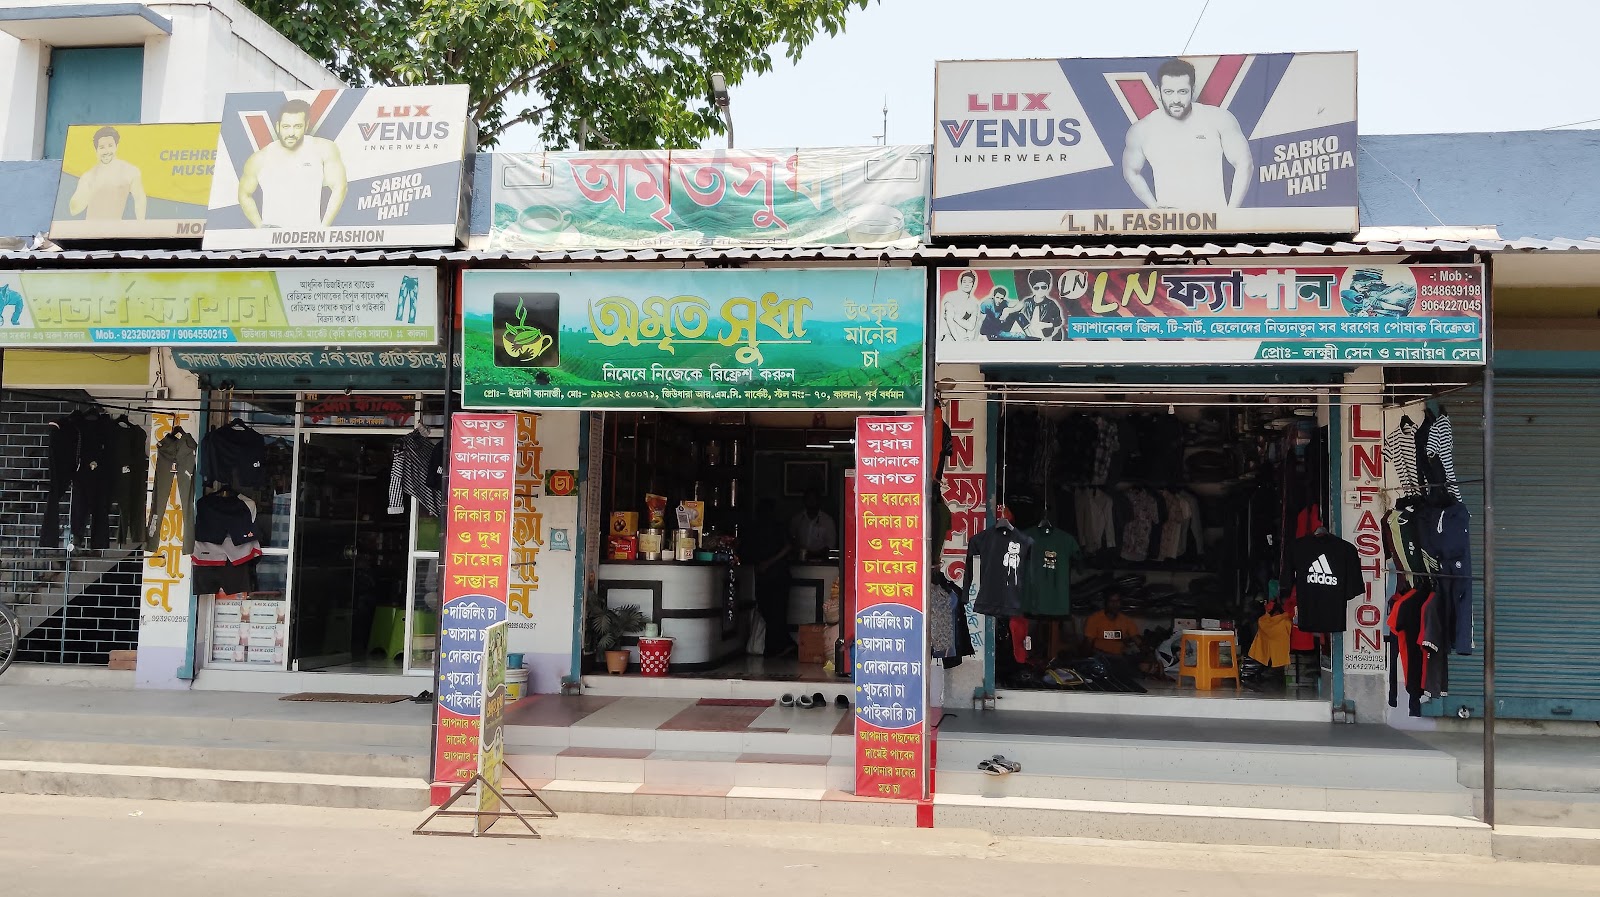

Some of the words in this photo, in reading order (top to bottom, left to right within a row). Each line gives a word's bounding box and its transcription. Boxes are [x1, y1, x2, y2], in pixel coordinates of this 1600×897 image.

[968, 92, 1051, 112] LUX
[377, 105, 432, 118] LUX
[358, 121, 449, 141] VENUS
[940, 118, 1081, 148] VENUS
[1274, 136, 1339, 162] SABKO
[955, 154, 1067, 162] INNERWEAR
[1260, 151, 1355, 183] MAANGTA
[371, 173, 422, 194] SABKO
[1287, 174, 1327, 196] HAI!
[358, 185, 431, 210] MAANGTA
[377, 203, 409, 220] HAI!
[1069, 214, 1085, 231] L.
[1094, 214, 1114, 231] N.
[1123, 213, 1217, 230] FASHION
[271, 231, 325, 244] MODERN
[329, 230, 384, 242] FASHION
[1440, 271, 1462, 281] Mob
[1092, 270, 1157, 313] LN
[1161, 269, 1337, 312] ফ্যাশান
[1421, 285, 1481, 296] 8348639198
[843, 298, 899, 325] উৎকৃষ্ট
[1421, 300, 1481, 311] 9064227045
[121, 329, 171, 340] 9232602987
[178, 329, 228, 340] 9064550215
[588, 296, 710, 355] অমৃত
[718, 292, 813, 366] সুধা
[844, 326, 898, 345] মানের
[1072, 321, 1133, 334] ফ্যাশানেবল
[1210, 321, 1261, 335] ছেলেদের
[1265, 319, 1315, 338] নিত্যনতুন
[1319, 322, 1336, 334] সব
[1341, 322, 1379, 335] ধরণের
[1384, 321, 1426, 335] পোষাক
[1430, 319, 1475, 334] বিক্রেতা
[861, 349, 879, 368] চা
[1345, 348, 1372, 360] সেন
[1378, 349, 1389, 359] ও
[1394, 347, 1446, 360] নারায়ণ
[1452, 348, 1481, 360] সেন
[602, 362, 646, 381] নিমেষে
[651, 362, 702, 381] নিজেকে
[709, 363, 752, 381] রিফ্রেশ
[759, 367, 795, 381] করুন
[590, 390, 620, 398] ৯৯৩২২
[834, 389, 861, 400] কালনা,
[880, 387, 904, 398] বর্ধমান
[461, 419, 507, 432] অমৃত
[866, 422, 914, 435] অমৃত
[461, 436, 505, 449] সুধায়
[867, 439, 912, 453] সুধায়
[455, 453, 511, 464] আপনাকে
[861, 456, 919, 467] আপনাকে
[457, 469, 507, 481] স্বাগত
[864, 473, 916, 485] স্বাগত
[554, 475, 570, 491] চা
[453, 488, 470, 500] সব
[473, 488, 510, 501] ধরনের
[860, 493, 877, 506] সব
[882, 493, 920, 506] ধরনের
[453, 505, 491, 523] লিকার
[494, 509, 507, 523] চা
[862, 511, 902, 529] লিকার
[905, 515, 918, 528] চা
[457, 532, 471, 543] ও
[477, 532, 502, 549] দুধ
[868, 538, 882, 550] ও
[888, 538, 914, 555] দুধ
[452, 552, 504, 567] চায়ের
[862, 559, 917, 574] চায়ের
[449, 602, 486, 620] দার্জিলিং
[487, 606, 497, 620] চা
[863, 611, 902, 630] দার্জিলিং
[903, 615, 913, 630] চা
[448, 628, 477, 642] আসাম
[863, 639, 893, 652] আসাম
[895, 639, 905, 652] চা
[864, 661, 908, 676] দোকানের
[911, 662, 922, 676] চা
[447, 671, 475, 689] খুচরো
[863, 683, 892, 701] খুচরো
[895, 684, 905, 698] চা
[863, 702, 903, 722] পাইকারি
[906, 707, 916, 722] চা
[441, 718, 469, 729] আপনার
[446, 734, 467, 746] দামেই
[860, 731, 889, 742] আপনার
[443, 752, 471, 762] আপনার
[865, 747, 887, 759] দামেই
[890, 750, 914, 760] পাবেন
[863, 766, 893, 777] আপনার
[892, 784, 900, 794] চা
